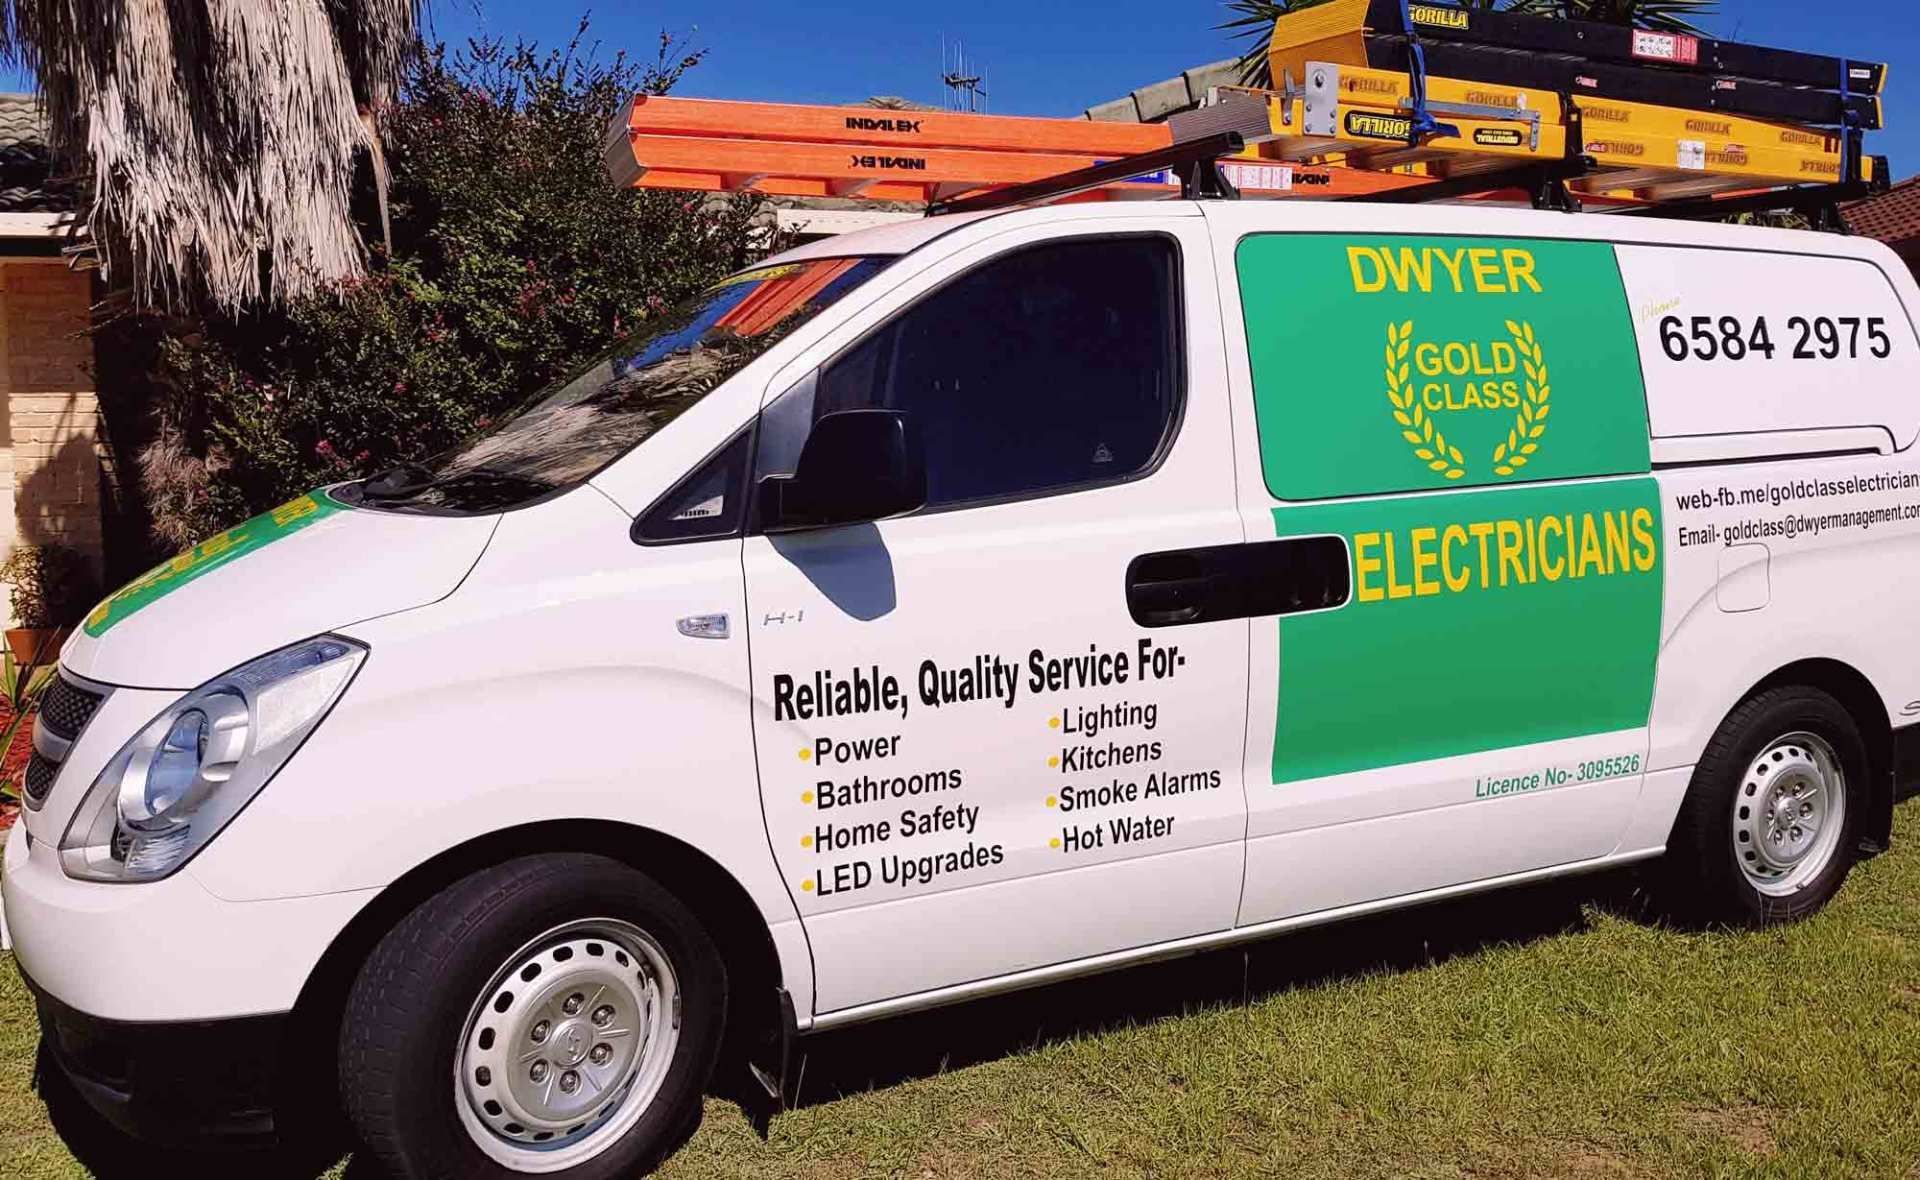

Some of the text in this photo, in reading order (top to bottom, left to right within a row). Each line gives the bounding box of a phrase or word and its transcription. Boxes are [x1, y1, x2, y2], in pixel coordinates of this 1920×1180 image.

[846, 117, 921, 133] INDALEX
[851, 155, 926, 169] INDALEX
[1347, 246, 1543, 293] DWYER
[1415, 341, 1517, 376] GOLD
[1659, 316, 1891, 361] 6584 2975
[1422, 381, 1521, 411] CLASS
[1676, 470, 1920, 511] web-fb.me/goldclasselectrician
[1354, 507, 1656, 602] ELECTRICIANS
[1678, 523, 1721, 547] Email-
[773, 638, 1185, 720] Reliable, Quality Service For-
[1063, 701, 1157, 734] Lighting
[815, 734, 901, 766] Power
[1062, 738, 1162, 773] Kitchens
[816, 768, 962, 810] Bathrooms
[1060, 767, 1221, 812] Smoke Alarms
[1475, 754, 1641, 798] Licence No- 3095526
[815, 803, 980, 854] Home Safety
[1063, 814, 1175, 854] Hot Water
[816, 842, 1004, 896] LED Upgrades
